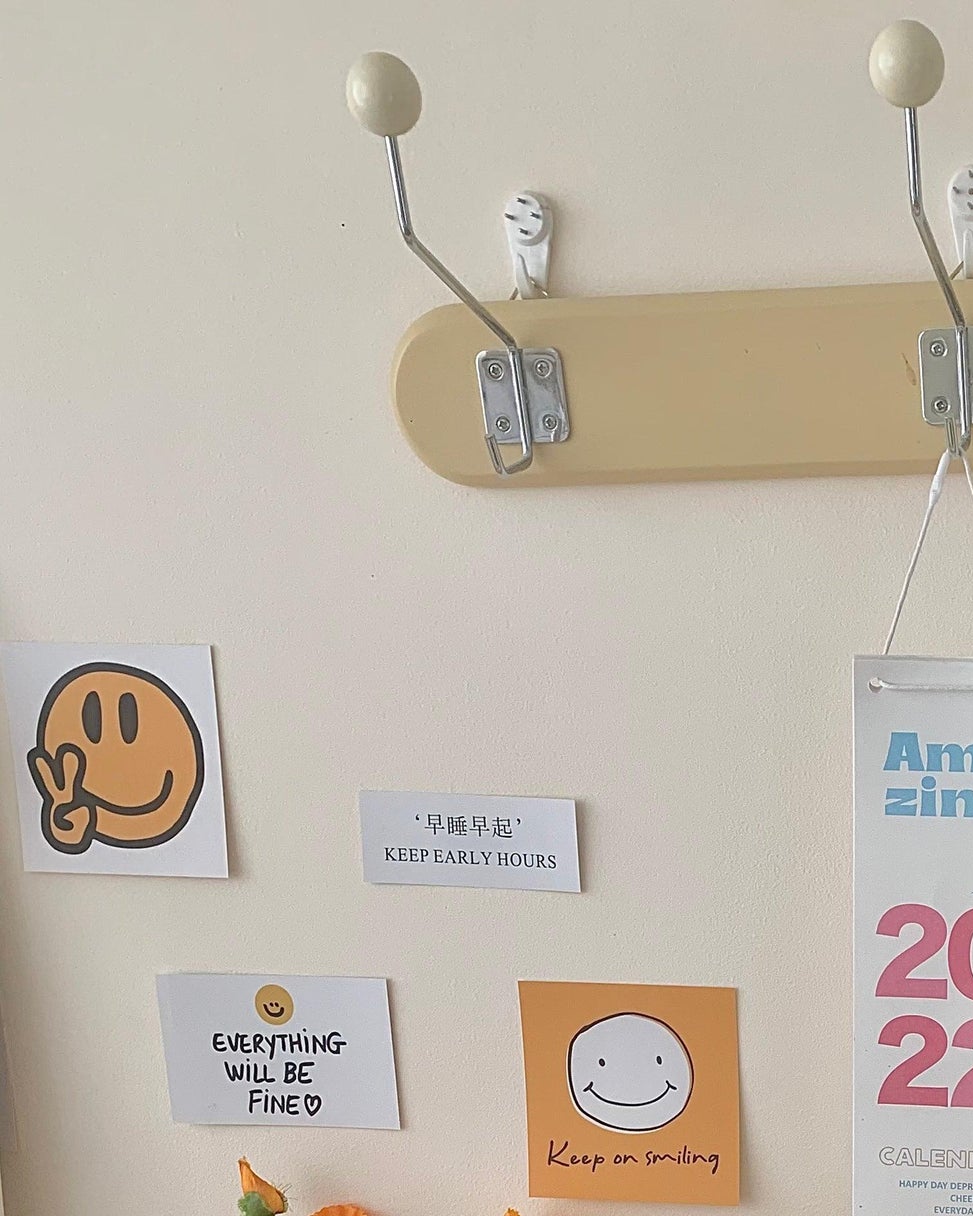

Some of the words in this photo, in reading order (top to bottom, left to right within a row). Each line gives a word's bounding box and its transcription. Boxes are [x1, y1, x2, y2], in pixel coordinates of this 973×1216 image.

[384, 847, 428, 862] KEEP
[434, 850, 492, 866] EARLY
[497, 852, 557, 868] HOURS
[283, 1061, 315, 1084] BE
[547, 1140, 604, 1172] Keep
[613, 1152, 638, 1165] on
[645, 1145, 720, 1174] smiling
[899, 1180, 928, 1189] HAPPY
[931, 1181, 948, 1190] DAY
